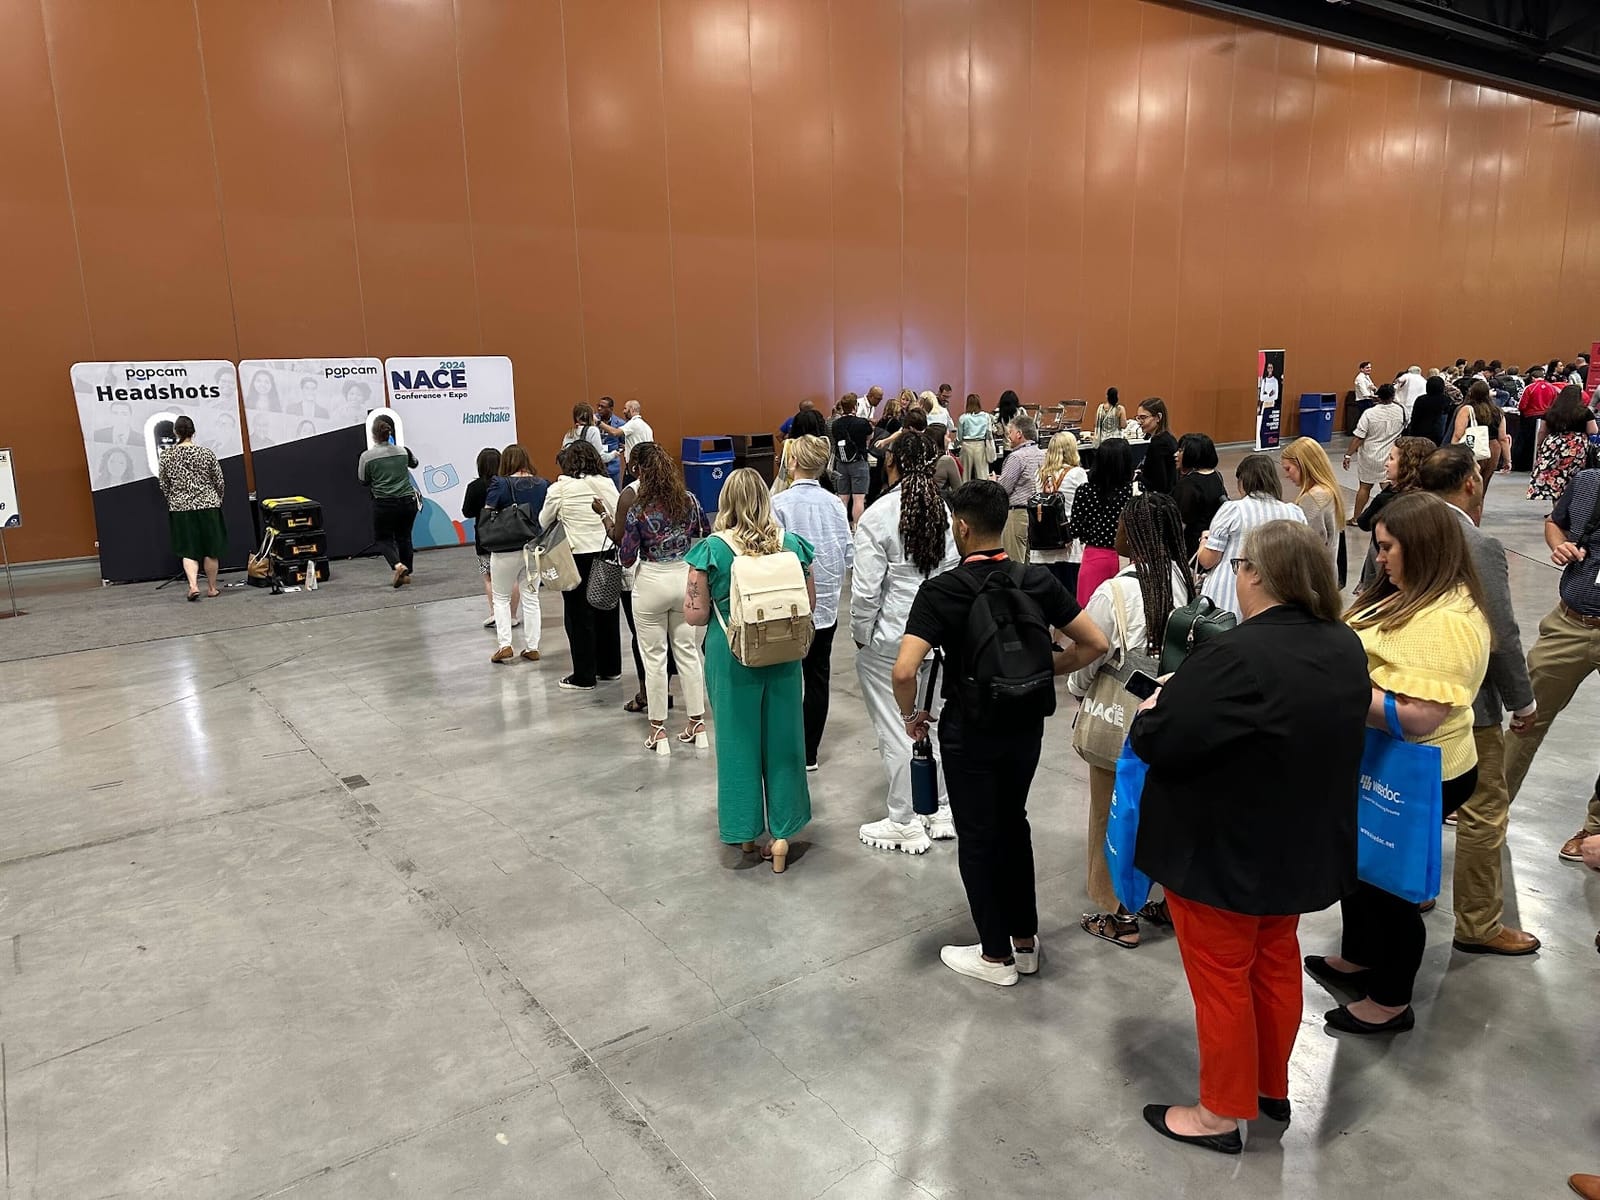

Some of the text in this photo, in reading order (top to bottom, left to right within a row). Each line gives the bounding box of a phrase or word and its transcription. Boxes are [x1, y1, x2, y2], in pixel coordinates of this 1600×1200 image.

[325, 365, 377, 379] popcam
[440, 361, 466, 369] 2024
[126, 367, 187, 381] popcam
[391, 369, 467, 390] NACE
[96, 383, 221, 402] Headshots
[394, 391, 468, 400] Conference Expo
[462, 411, 510, 424] Handshake
[1083, 698, 1124, 727] NACE
